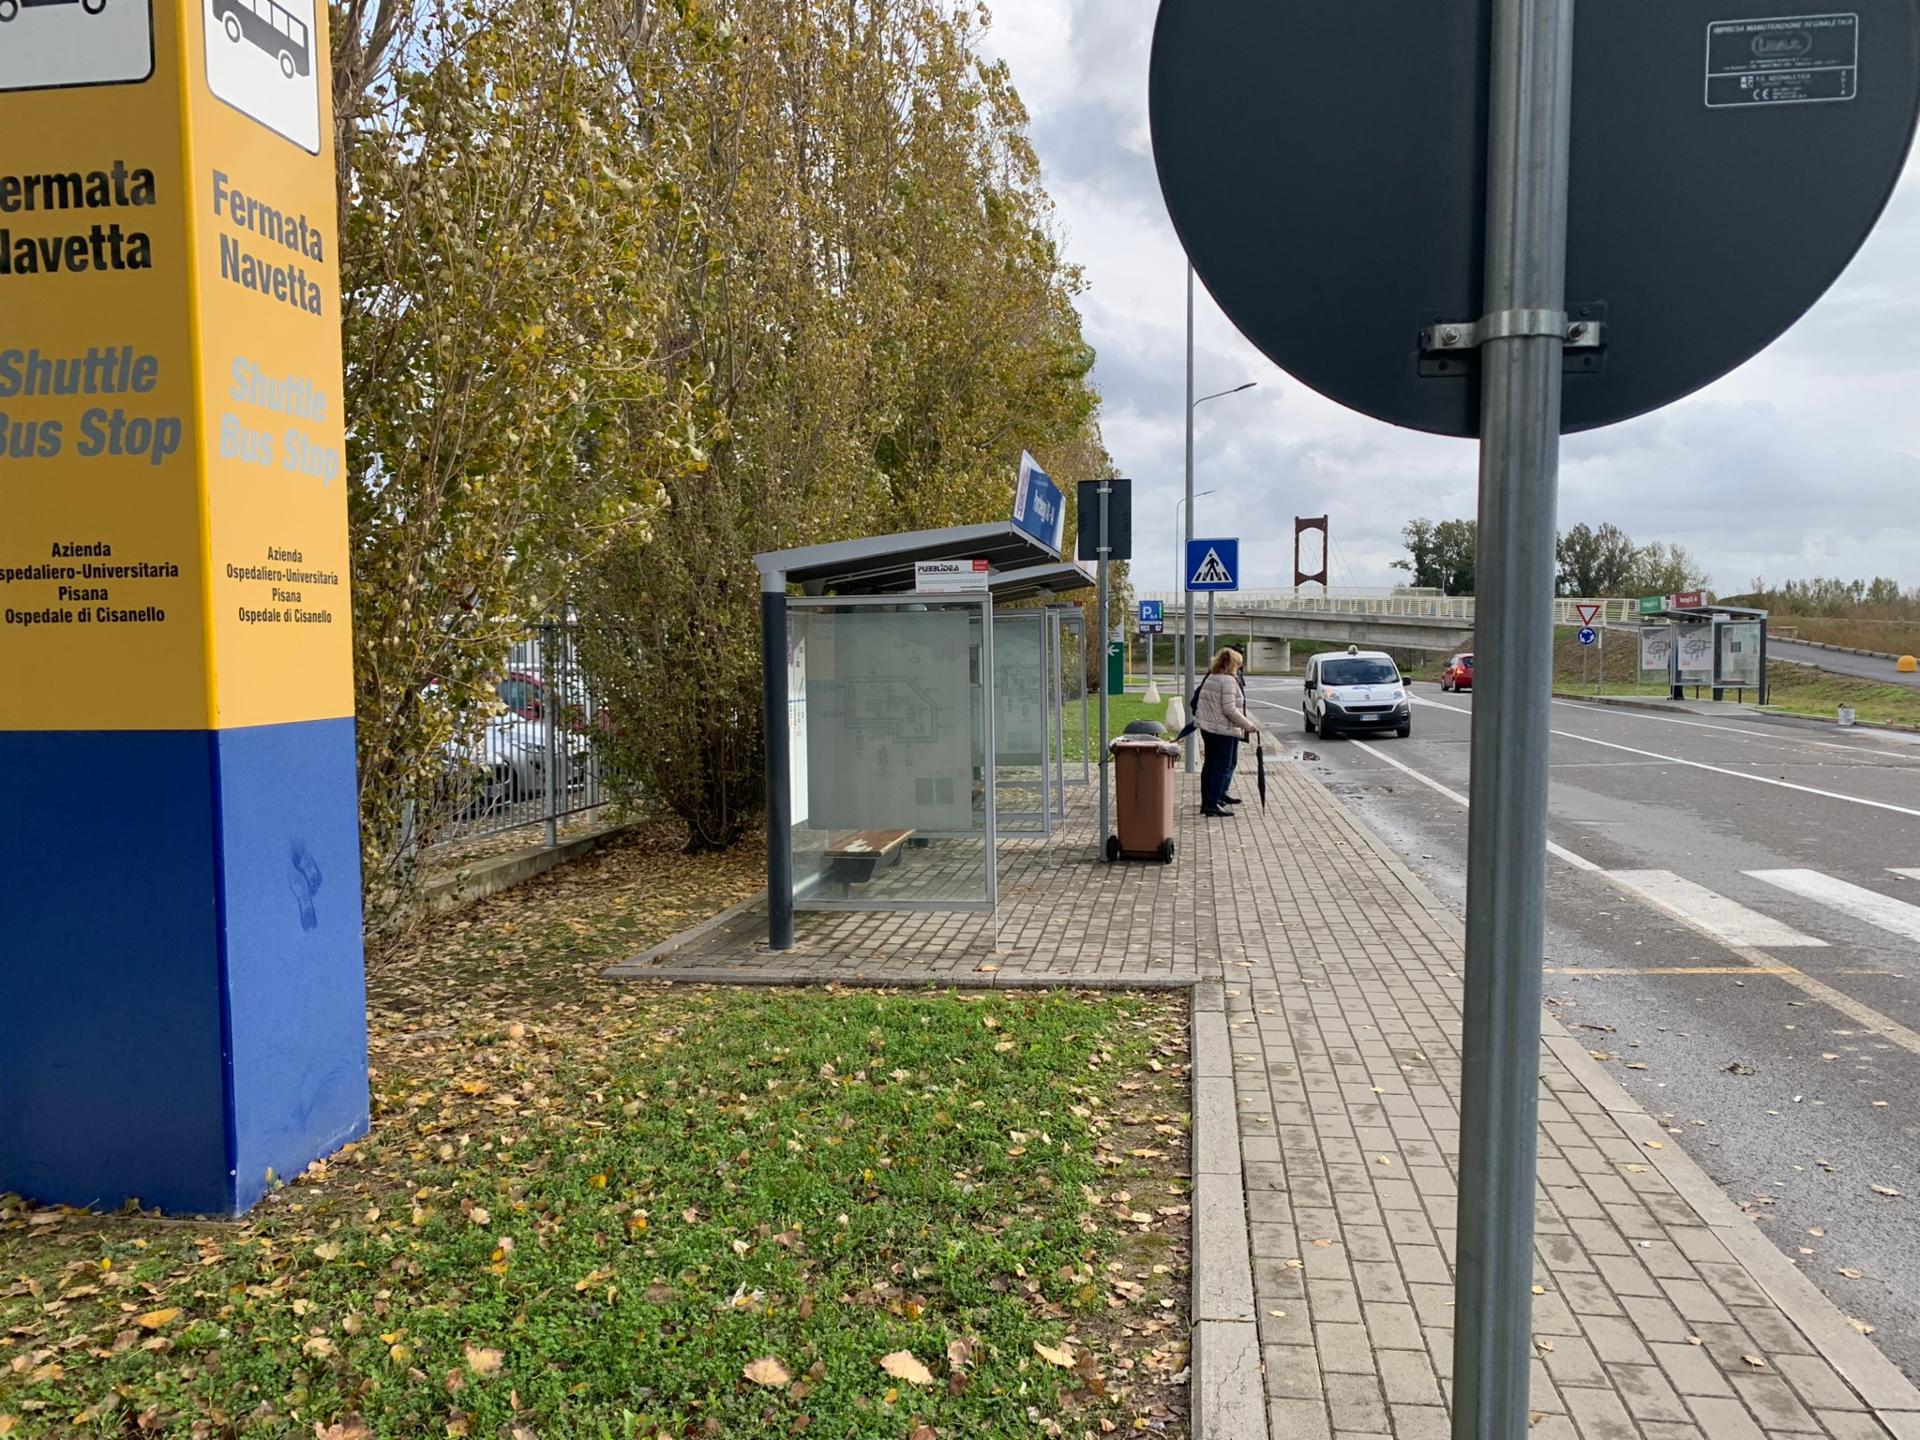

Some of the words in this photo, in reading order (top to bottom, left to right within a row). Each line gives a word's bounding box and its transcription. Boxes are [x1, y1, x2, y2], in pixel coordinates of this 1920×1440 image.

[0, 160, 156, 213] ermata
[212, 169, 323, 263] Fermata
[219, 233, 322, 316] Navetta
[0, 346, 158, 397] Shuttle
[230, 355, 327, 424] Shuttle
[78, 407, 182, 465] Stop
[220, 412, 273, 467] Bus
[282, 428, 339, 489] Stop
[52, 542, 111, 558] Azienda
[268, 546, 303, 563] Azienda
[0, 562, 179, 583] spedaliero-Universitaria
[226, 563, 338, 585] Ospedaliero-Universitaria
[58, 586, 108, 601] Pisana
[272, 587, 302, 602] Pisana
[5, 608, 73, 627] Ospedale
[78, 607, 91, 623] di
[96, 606, 165, 623] Cisanello
[239, 607, 281, 625] Ospedale
[284, 608, 292, 623] di
[294, 608, 332, 623] Cisanello
